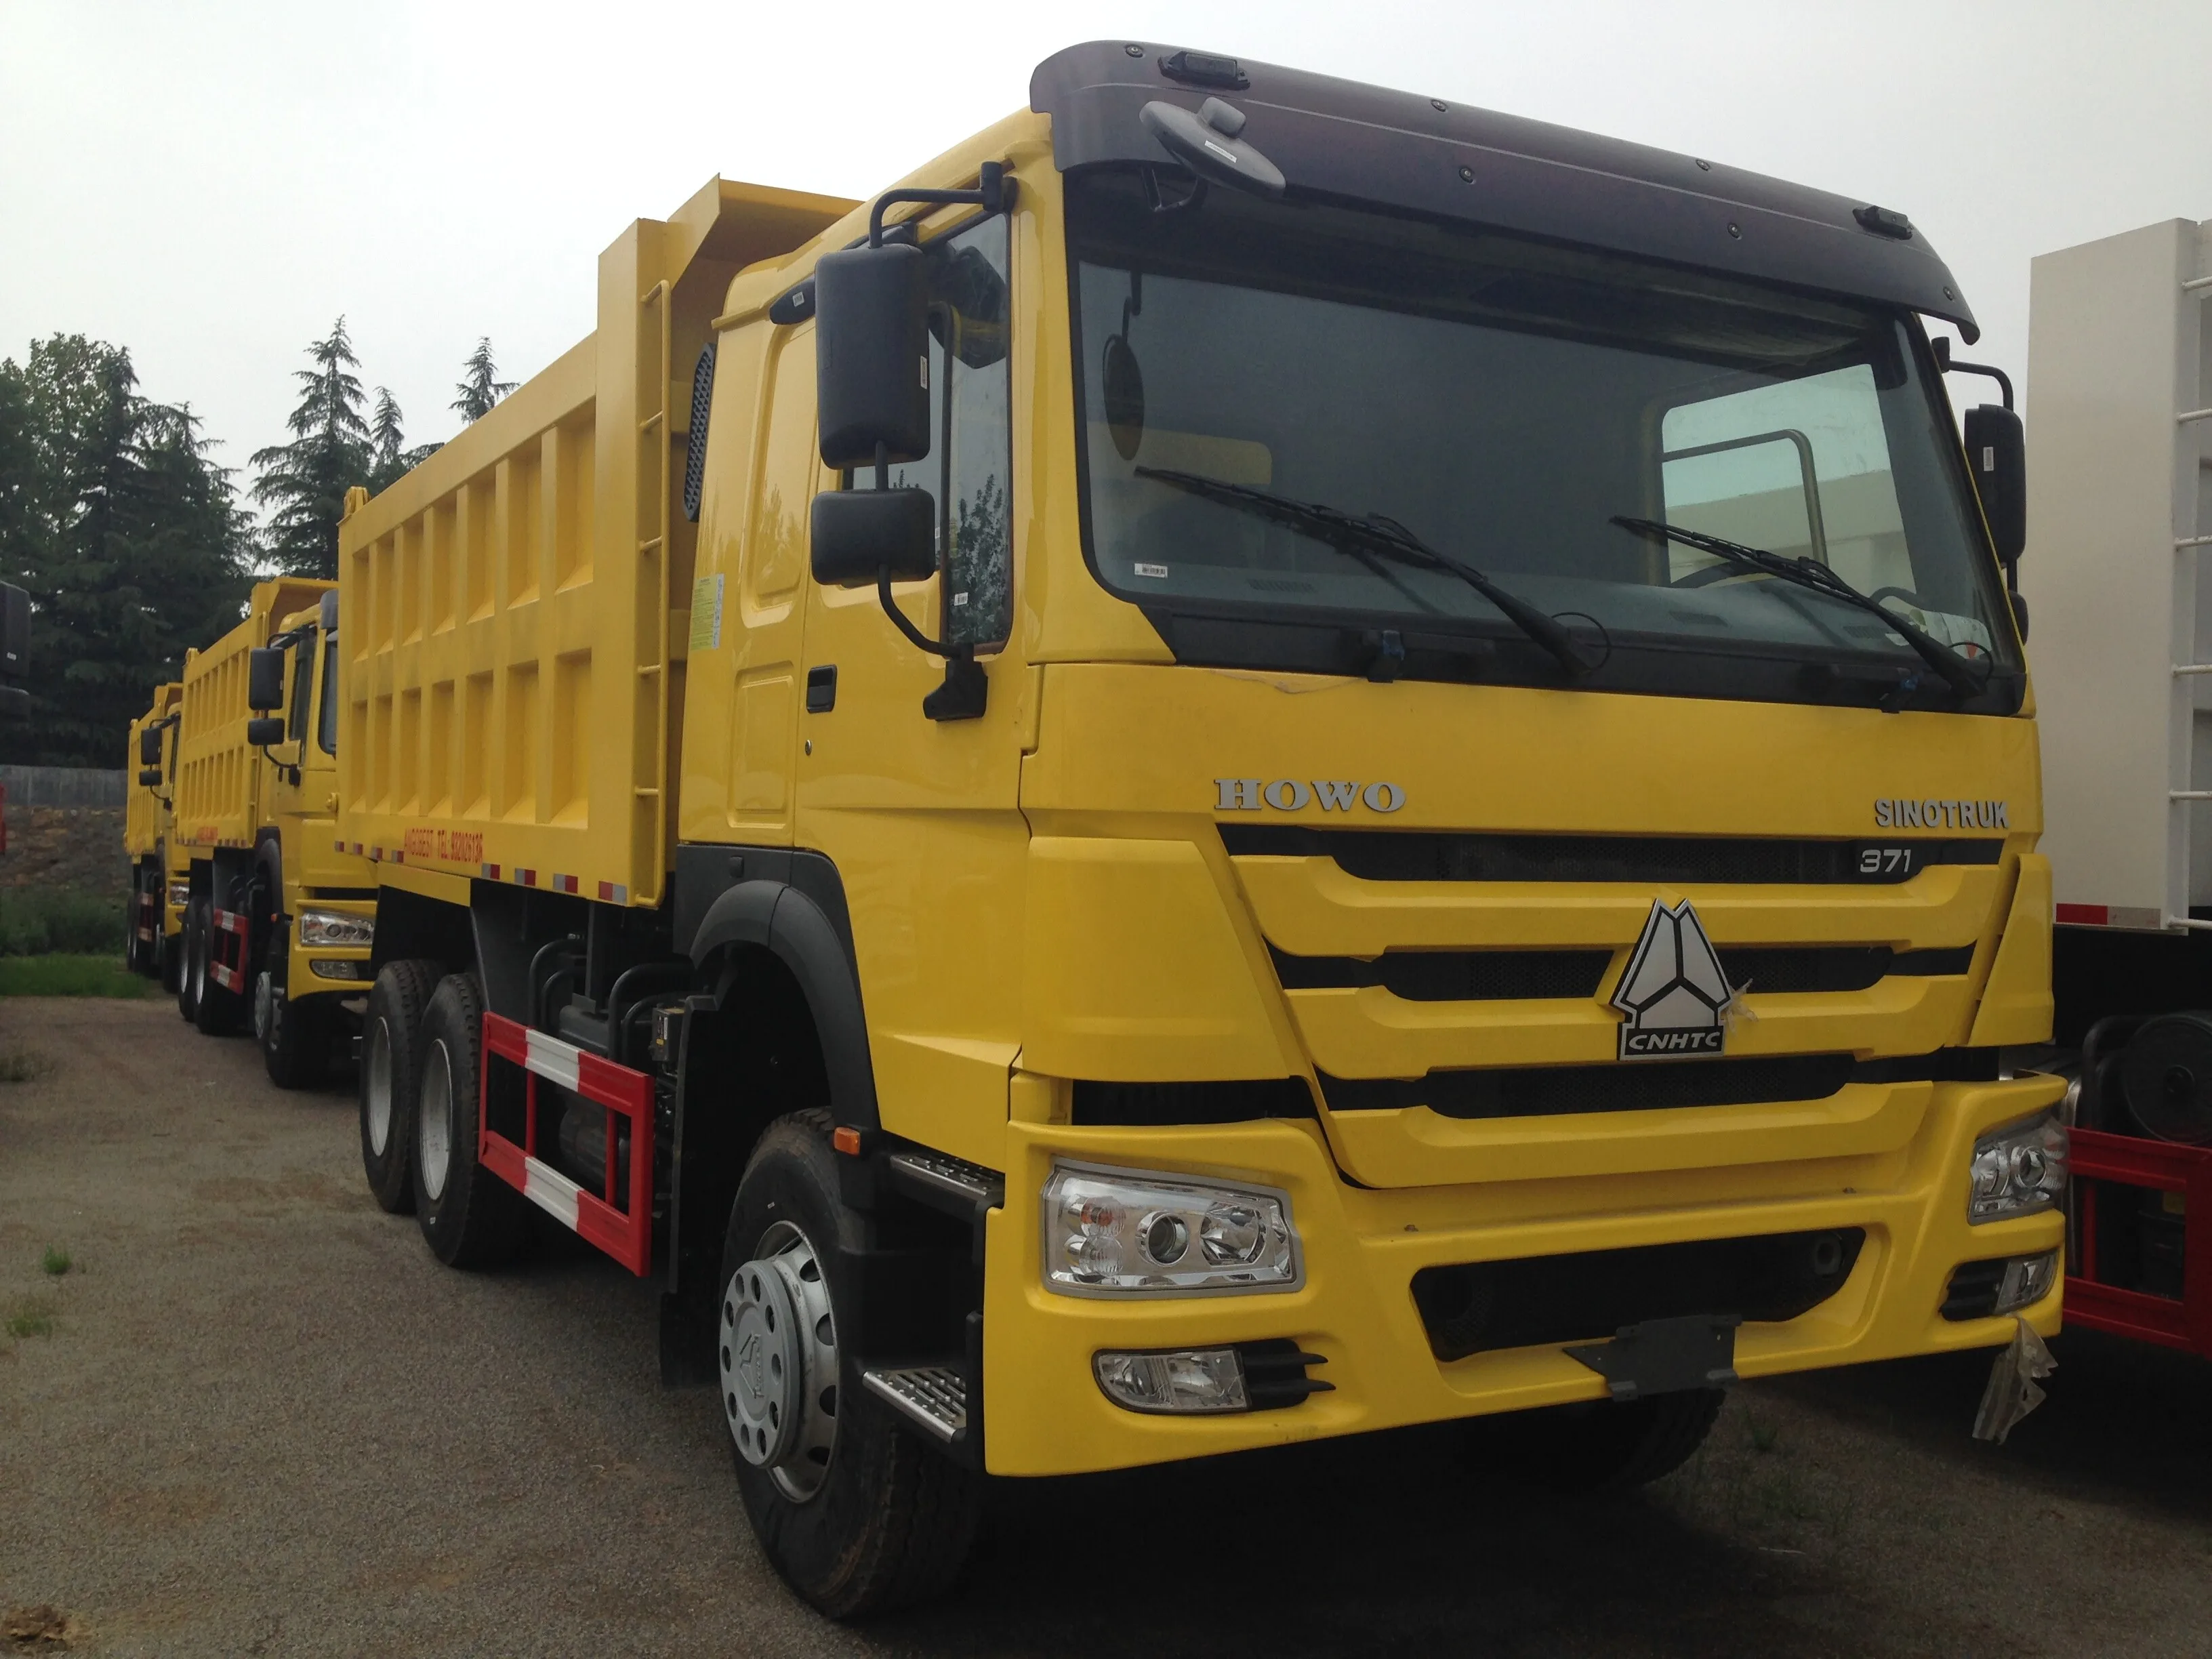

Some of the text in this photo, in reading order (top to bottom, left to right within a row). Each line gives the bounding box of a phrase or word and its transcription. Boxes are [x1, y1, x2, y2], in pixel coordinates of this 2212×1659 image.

[1214, 779, 1406, 812] HOWO
[1875, 798, 2009, 829] SINOTRUK
[1860, 848, 1911, 873] 371
[1628, 1031, 1721, 1051] CNHTC
